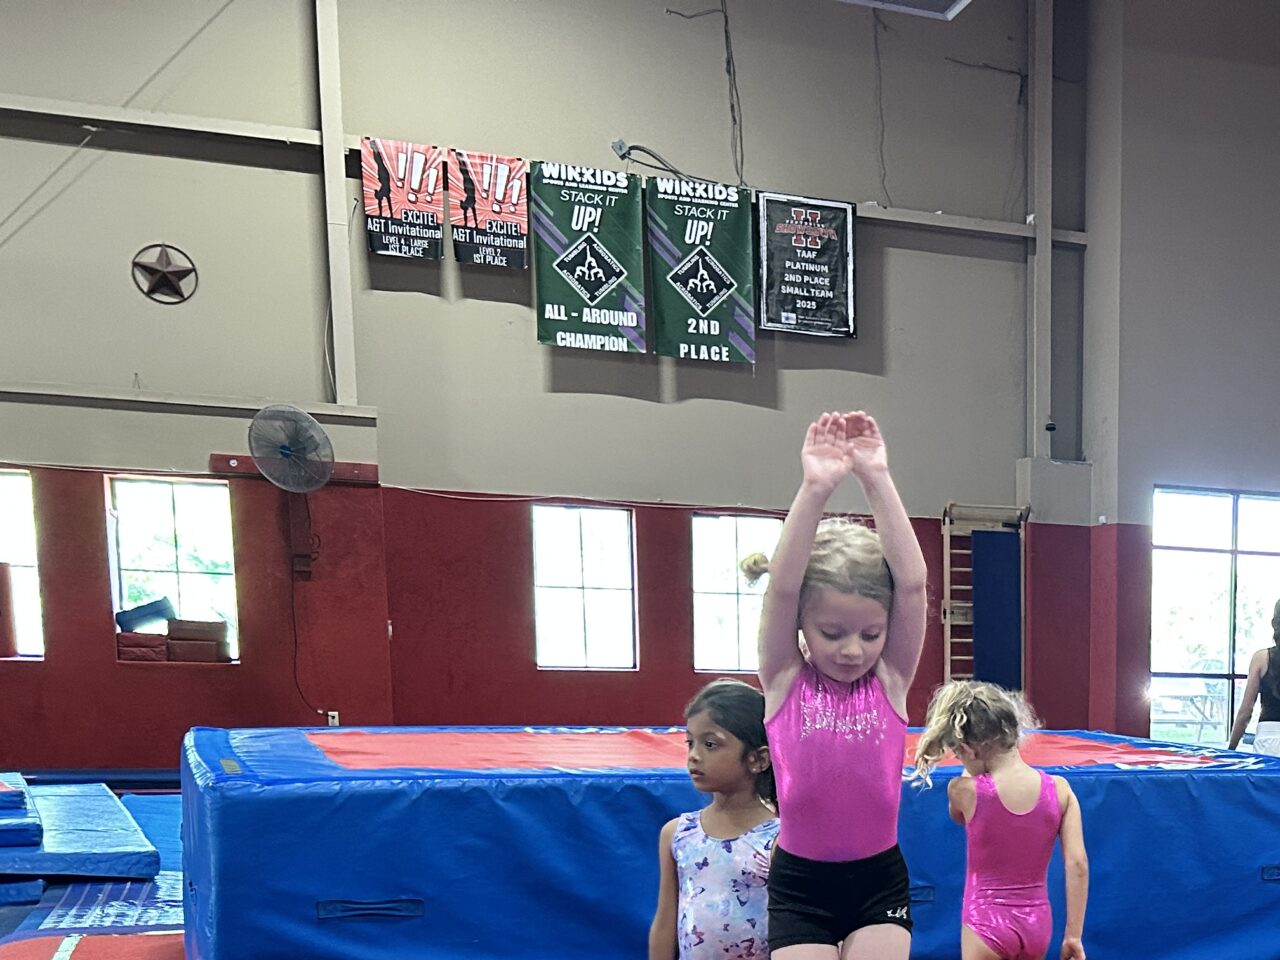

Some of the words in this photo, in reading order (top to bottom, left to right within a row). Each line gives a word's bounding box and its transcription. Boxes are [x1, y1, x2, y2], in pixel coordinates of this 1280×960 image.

[560, 189, 603, 205] STACK
[605, 195, 619, 207] IT
[401, 209, 437, 226] EXCITE!
[571, 205, 602, 233] UP!
[674, 204, 715, 219] STACK
[717, 209, 730, 221] IT
[389, 222, 443, 239] Invitational
[486, 219, 521, 236] EXCITE!
[684, 219, 714, 246] UP!
[382, 235, 400, 245] LEVEL
[410, 238, 429, 248] LARGE
[474, 234, 527, 249] Invitational
[402, 246, 424, 257] PLACE
[479, 247, 496, 255] LEVEL
[796, 249, 817, 259] TAAF
[486, 256, 507, 266] PLACE
[785, 260, 829, 273] PLATINUM
[784, 273, 802, 283] 2ND
[803, 275, 830, 286] PLACE
[781, 285, 810, 296] SMALL
[810, 288, 834, 299] TEAM
[796, 300, 817, 309] 2025
[545, 304, 568, 320] ALL
[582, 307, 638, 327] AROUND
[687, 318, 720, 335] 2ND
[556, 331, 628, 352] CHAMPION
[679, 343, 730, 362] PLACE
